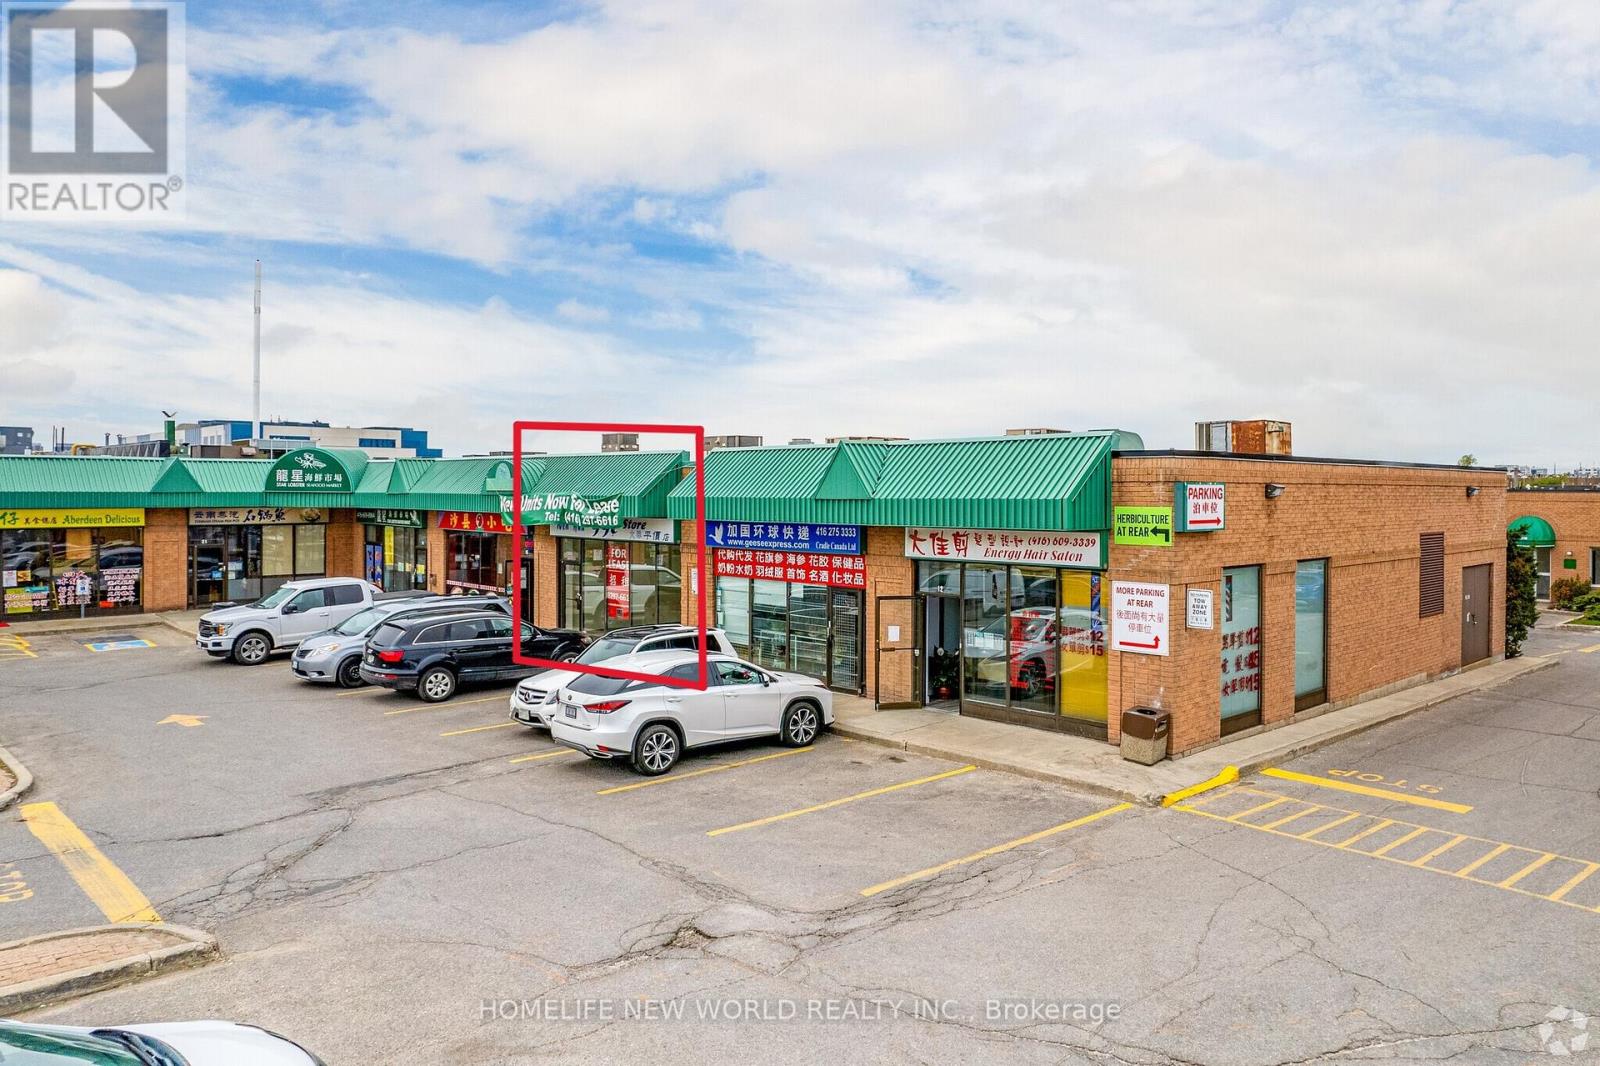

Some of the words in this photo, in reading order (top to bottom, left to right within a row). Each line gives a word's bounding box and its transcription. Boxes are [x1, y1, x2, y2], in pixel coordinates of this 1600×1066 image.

[1188, 487, 1223, 500] PARKING
[521, 494, 543, 511] Units
[544, 492, 569, 510] Now
[62, 514, 103, 524] Aberdeen
[105, 514, 140, 524] Delicious
[545, 512, 560, 521] Tel:
[582, 515, 618, 526] 297-6616
[623, 519, 646, 530] Store
[1117, 514, 1169, 524] HERBICULTURE
[727, 524, 810, 541] 加国环球快递
[816, 527, 827, 536] 416
[829, 527, 840, 537] 275
[841, 528, 856, 538] 3333
[1117, 527, 1126, 536] AT
[1128, 527, 1149, 537] REAR
[727, 539, 810, 550] www.geeseexpress.com
[831, 542, 847, 550] Canada
[1028, 536, 1050, 547] (416)
[611, 548, 626, 559] FOR
[984, 548, 1022, 560] Energy
[1023, 548, 1048, 560] Hair
[1050, 550, 1083, 562] Salon
[718, 549, 754, 562] 代购代发
[756, 552, 784, 564] 花旗参
[786, 554, 806, 566] 海参
[809, 555, 829, 567] 花胶
[832, 556, 864, 570] 保健品
[718, 562, 754, 576] 奶粉水奶
[756, 565, 784, 579] 羽绒服
[786, 567, 806, 581] 首饰
[832, 571, 864, 585] 化妆品
[1116, 586, 1135, 595] MORE
[1136, 588, 1165, 597] PARKING
[1127, 598, 1135, 606] AT
[1136, 599, 1153, 608] REAR
[1327, 768, 1444, 794] STOP
